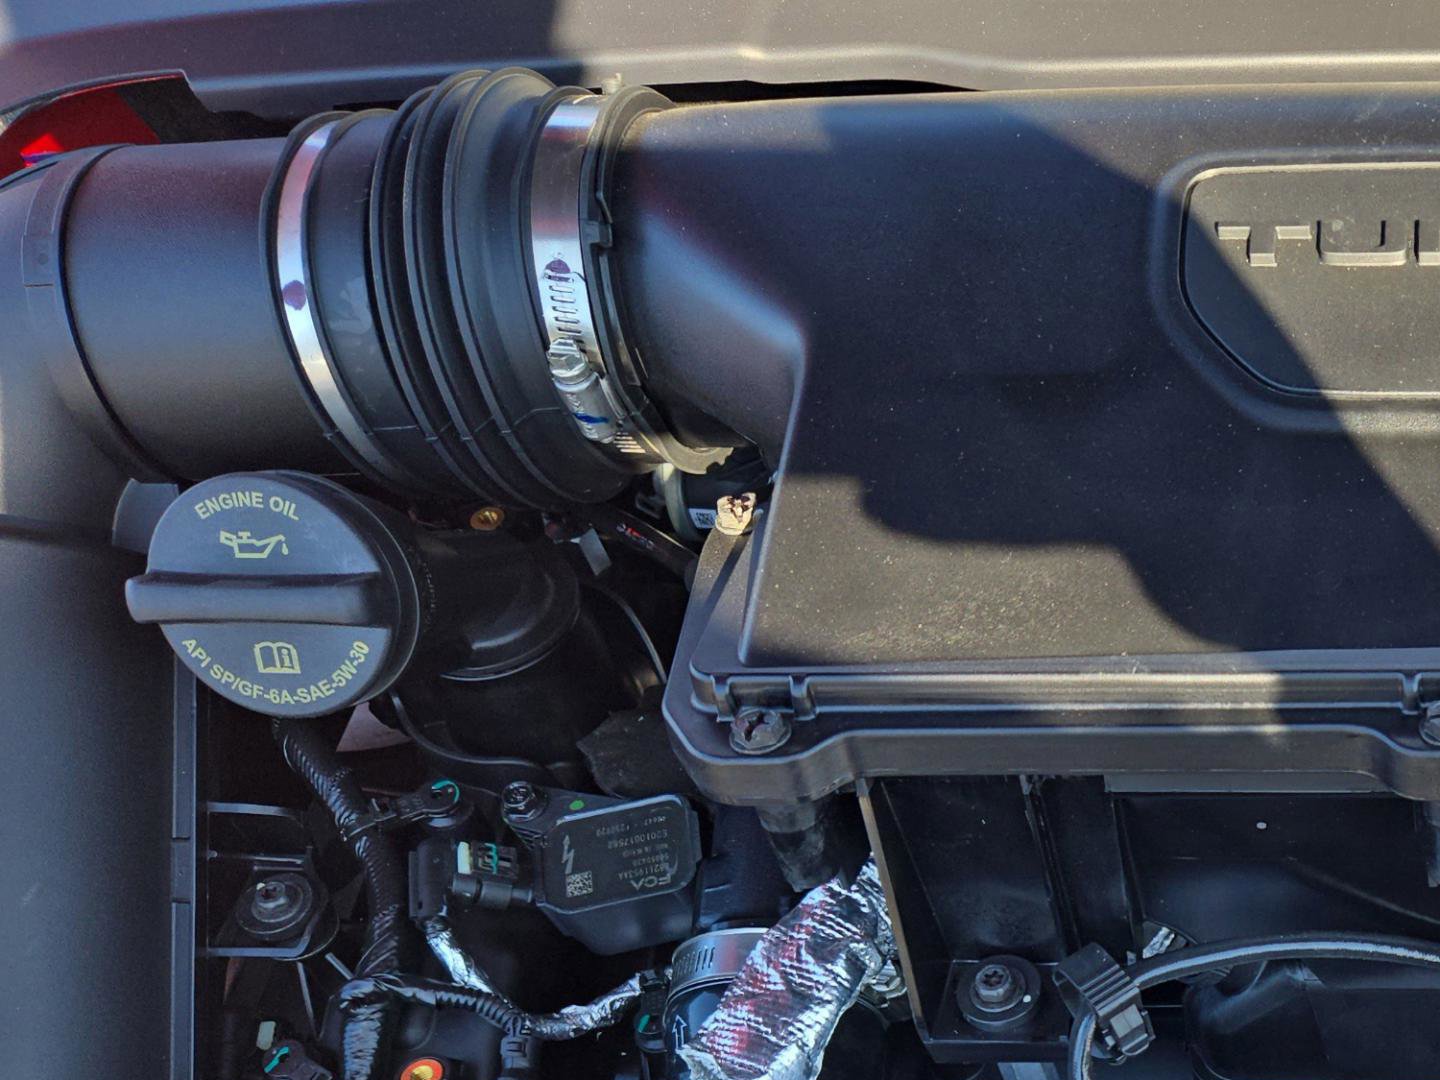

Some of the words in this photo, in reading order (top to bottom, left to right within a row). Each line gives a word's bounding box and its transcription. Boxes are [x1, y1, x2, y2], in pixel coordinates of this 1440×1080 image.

[194, 491, 264, 520] ENGINE
[269, 496, 300, 521] OIL
[182, 639, 212, 667] API
[209, 641, 370, 704] SP/GF-6A-SAE-5W-30
[629, 872, 672, 891] FCA
